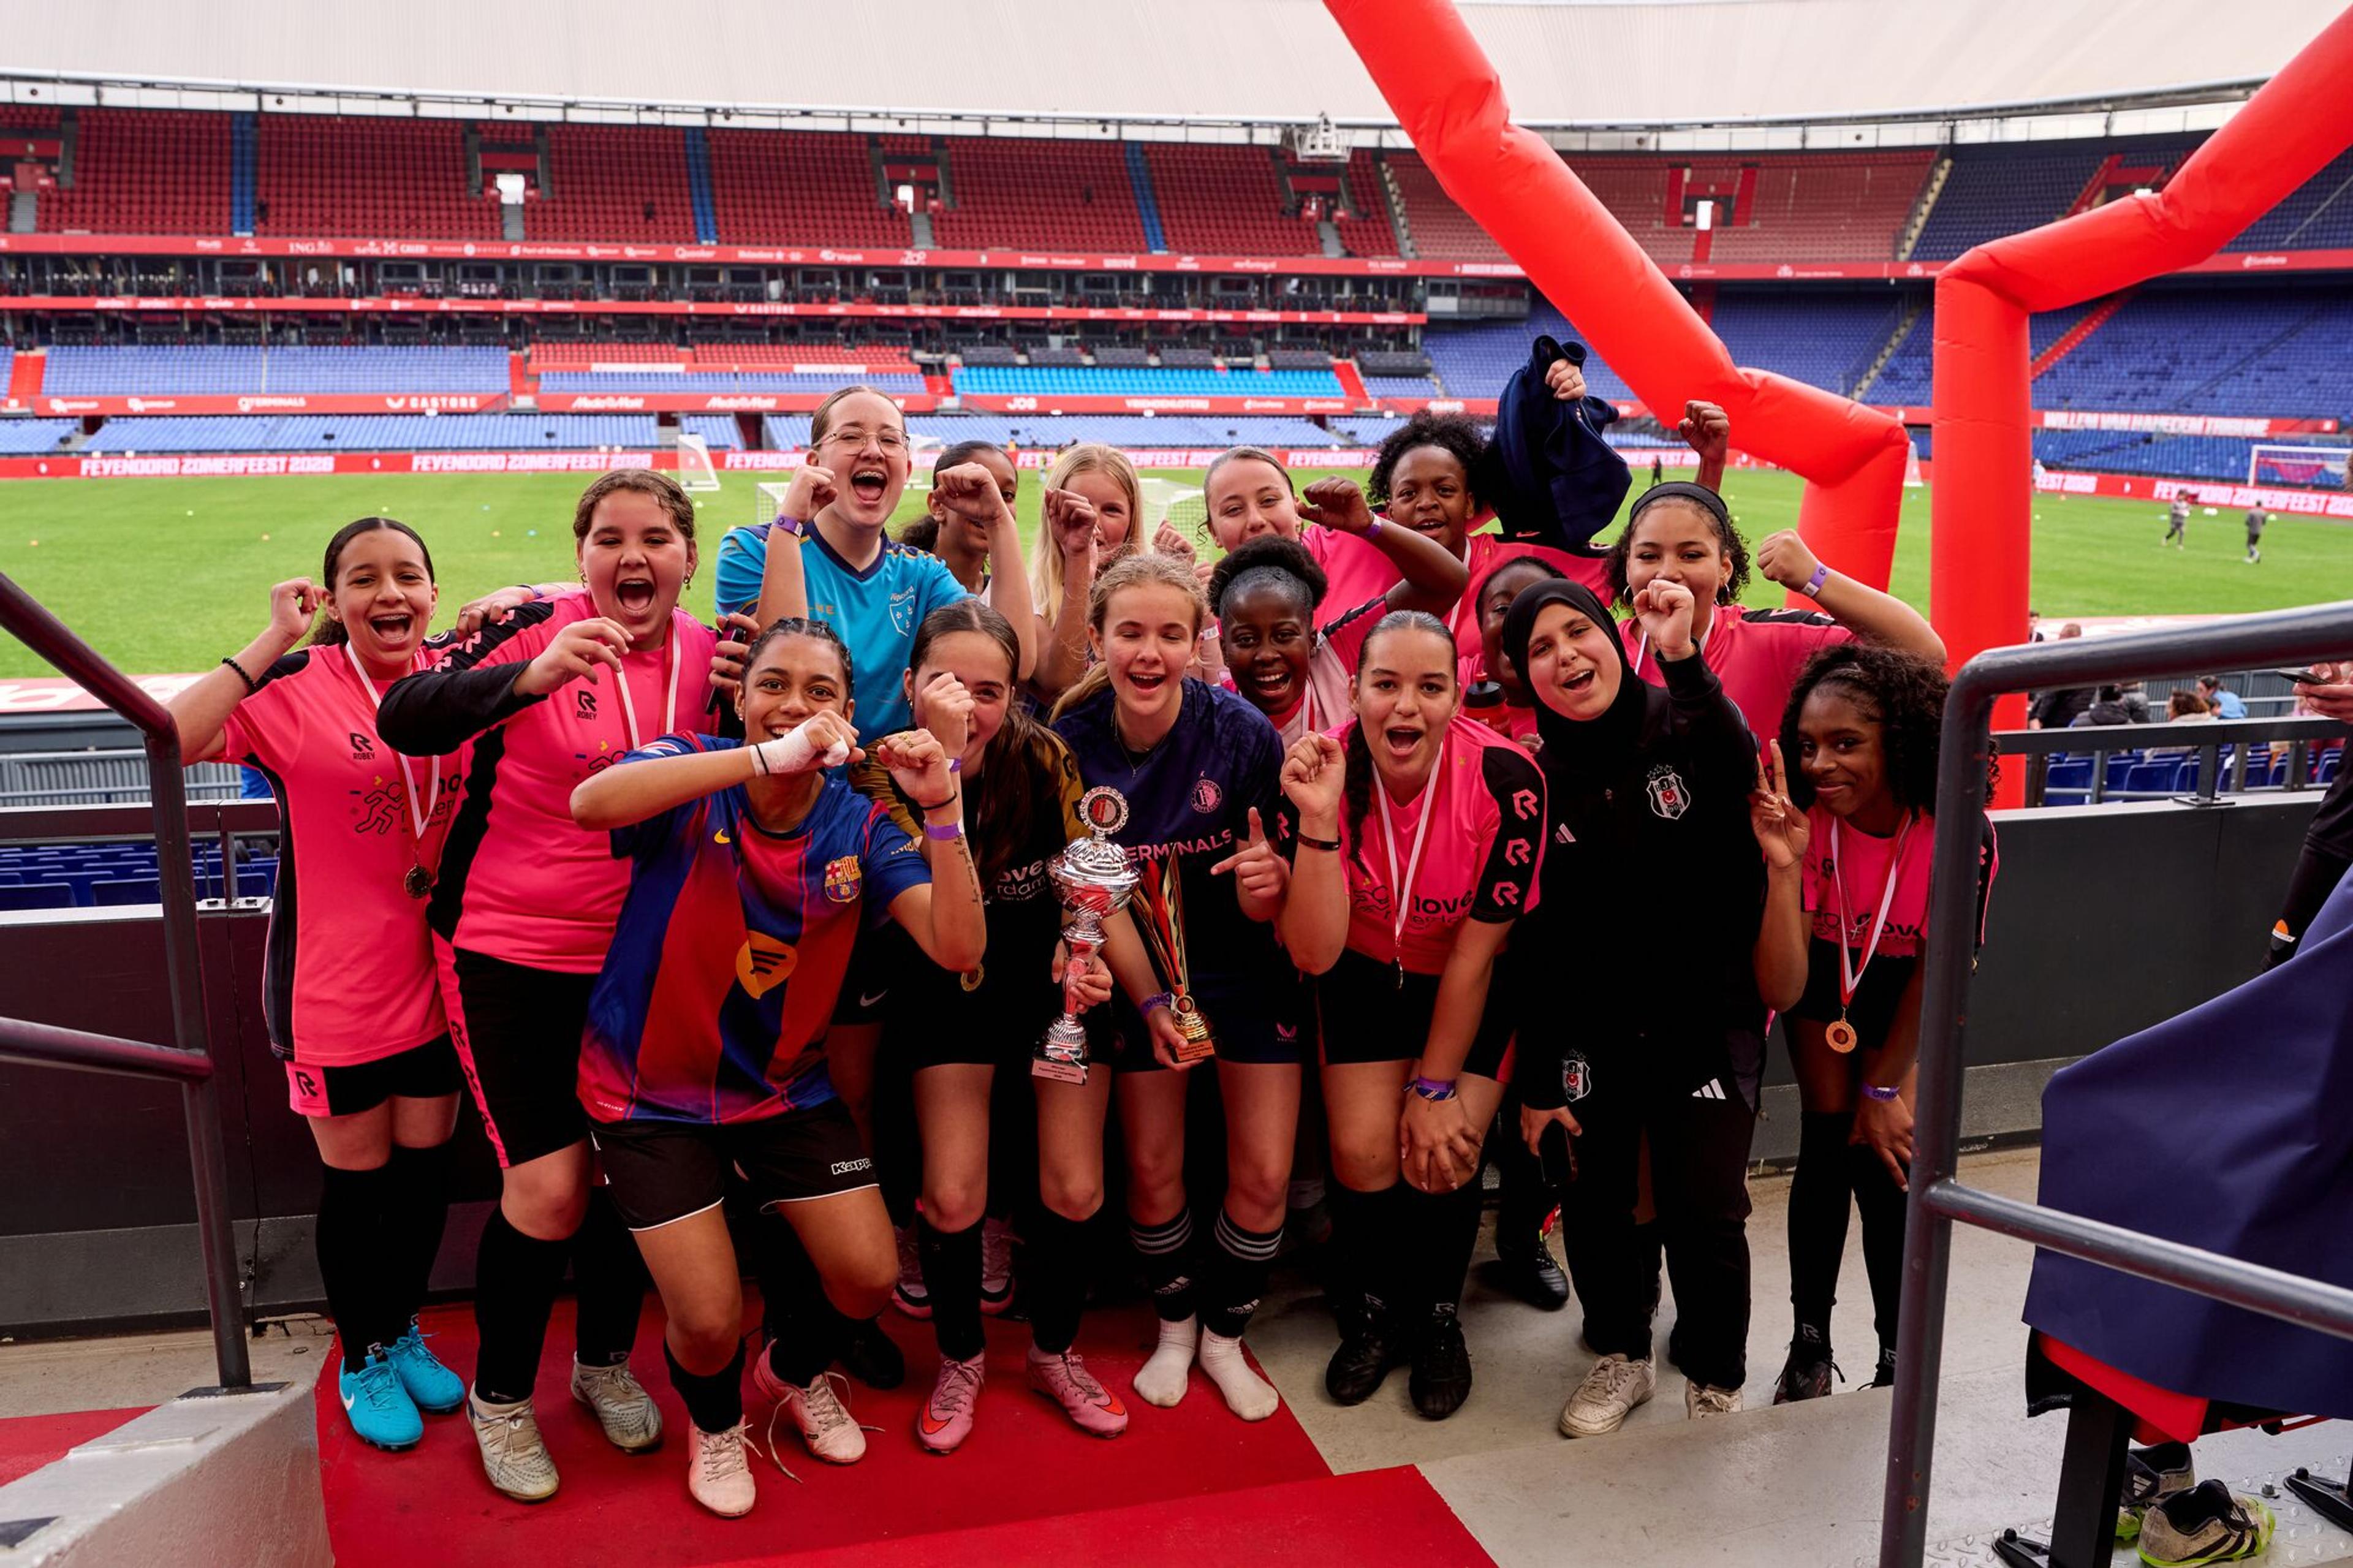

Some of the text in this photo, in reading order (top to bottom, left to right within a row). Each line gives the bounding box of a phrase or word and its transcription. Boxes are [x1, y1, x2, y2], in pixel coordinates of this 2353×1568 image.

[289, 243, 315, 252] ING
[80, 458, 180, 476] FEYENOORD
[180, 456, 288, 475] ZOMERFEEST
[411, 454, 507, 471] FEYENOORD
[506, 453, 609, 471] ZOMERFEEST
[576, 710, 597, 720] ROBEY
[352, 752, 376, 760] ROBEY
[830, 1157, 873, 1175] Kapp
